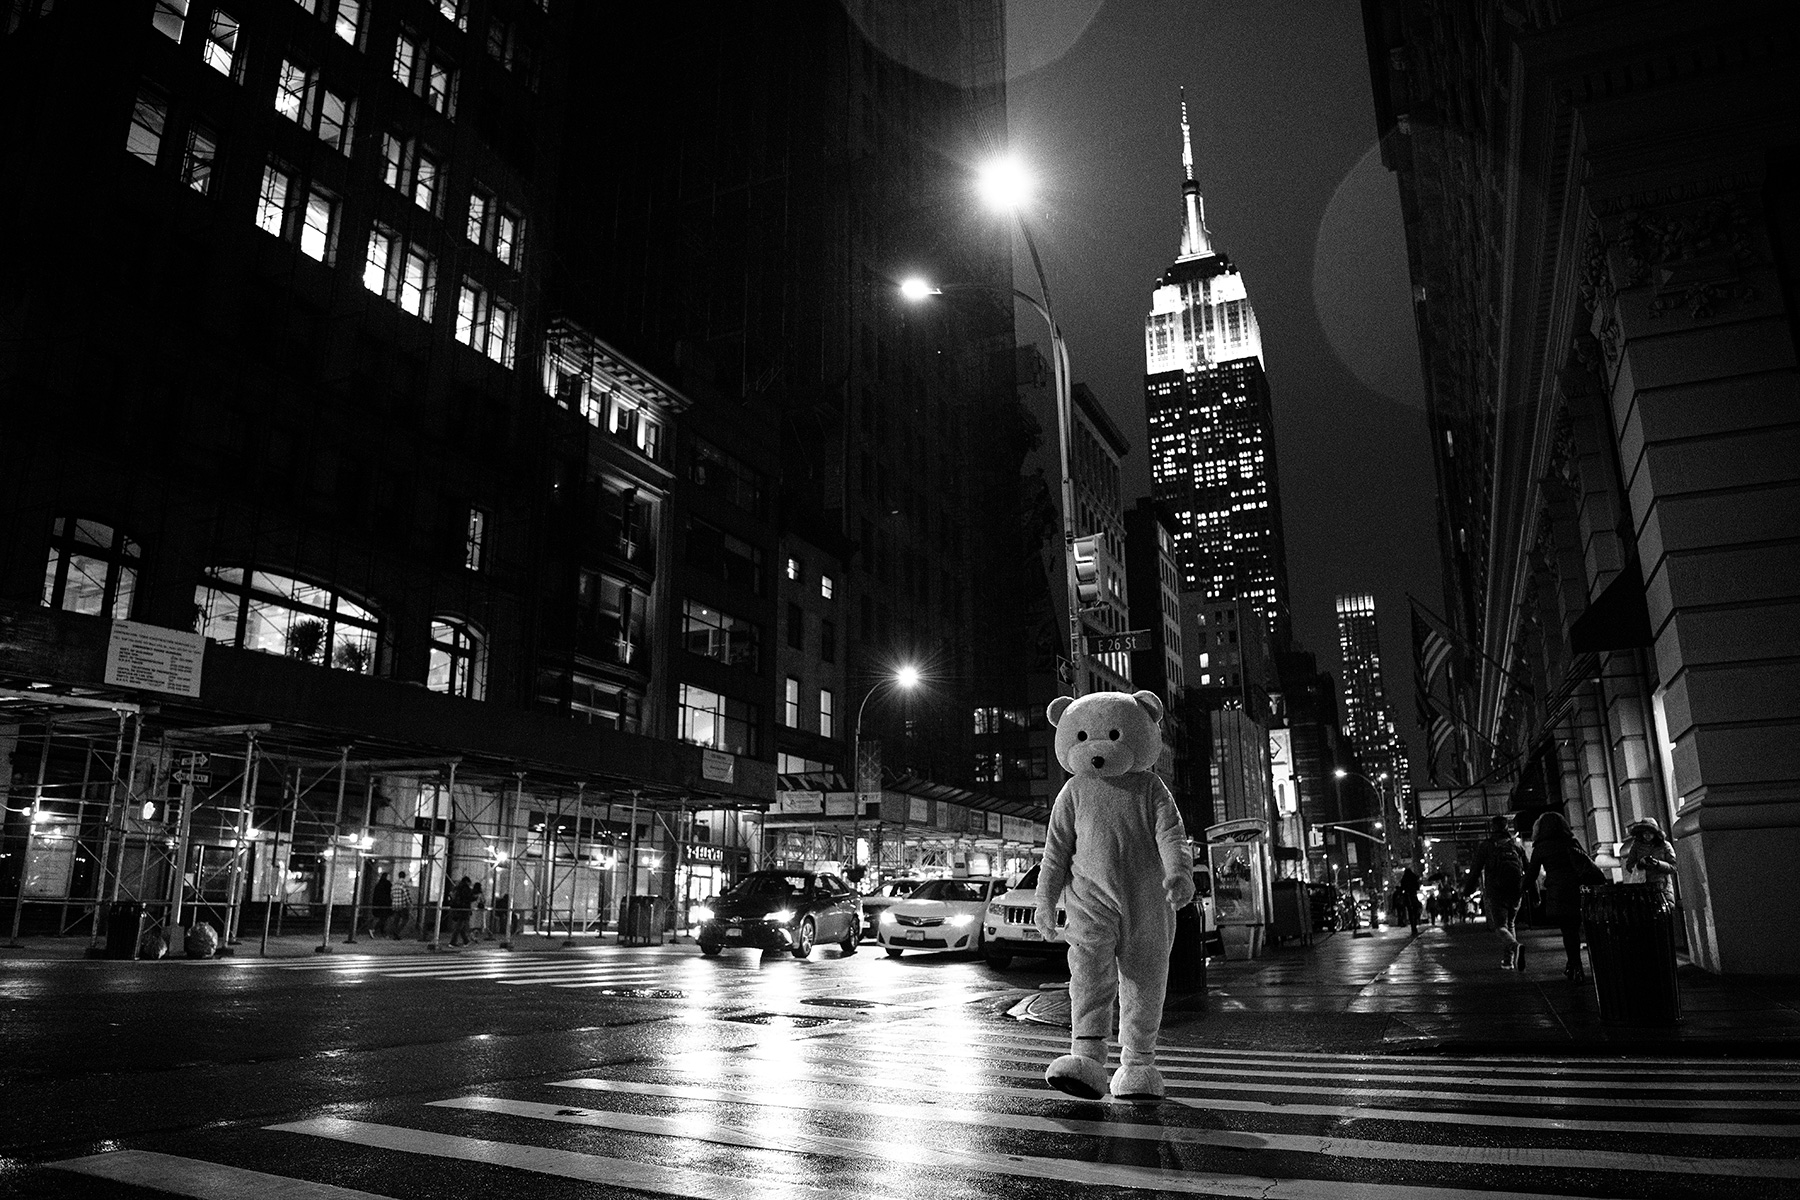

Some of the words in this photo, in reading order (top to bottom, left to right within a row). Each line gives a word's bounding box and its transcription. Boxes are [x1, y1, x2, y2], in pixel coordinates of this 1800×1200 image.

[1098, 640, 1103, 652] E
[1108, 638, 1120, 651] 26
[1125, 636, 1136, 650] St
